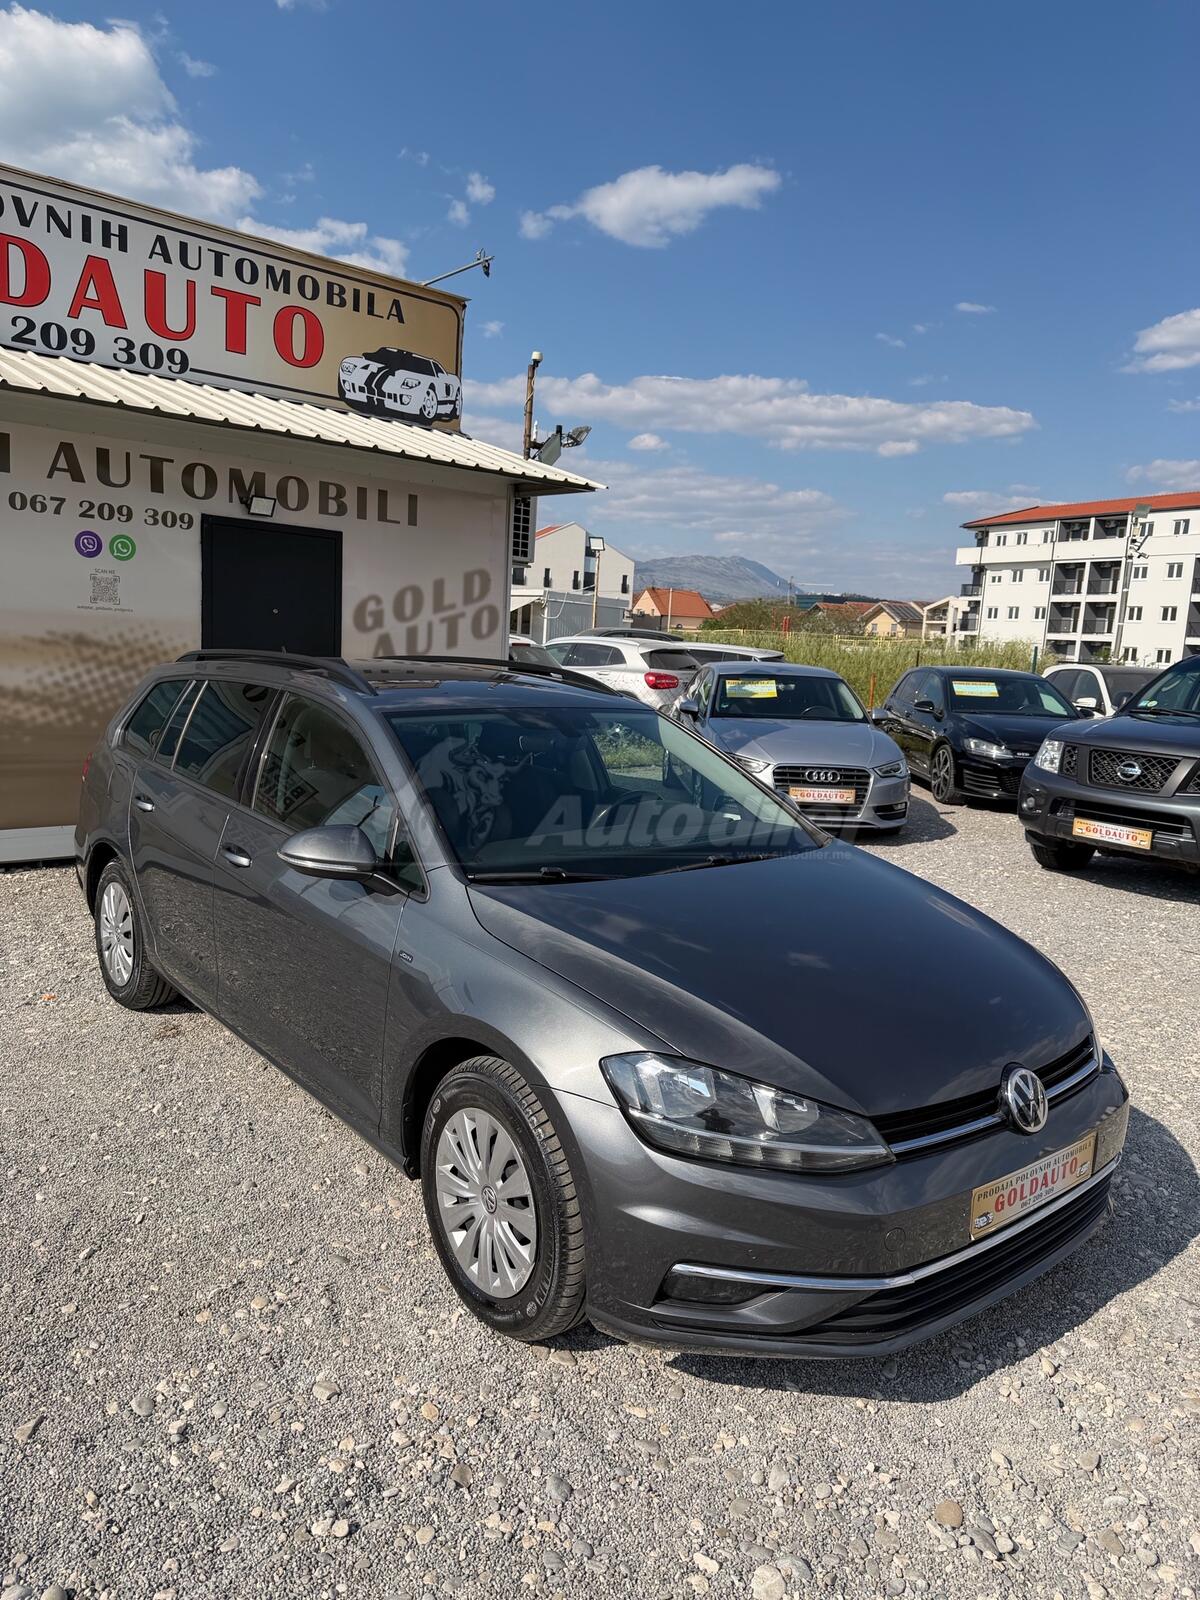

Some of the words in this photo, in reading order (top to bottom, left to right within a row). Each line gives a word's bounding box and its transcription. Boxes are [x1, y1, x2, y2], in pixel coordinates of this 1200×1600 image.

[0, 195, 128, 252] VNIH
[149, 235, 406, 323] AUTOMOBILA
[0, 233, 324, 368] DAUTO
[11, 316, 96, 356] 209
[113, 337, 190, 374] 309
[8, 491, 66, 515] 067
[79, 500, 133, 522] 209
[144, 508, 193, 530] 309
[46, 441, 418, 527] AUTOMOBILI
[352, 568, 492, 634] GOLD
[373, 603, 500, 656] AUTO
[1085, 826, 1138, 841] GOLDAUTO
[977, 1180, 1013, 1202] PRODAJA
[994, 1157, 1079, 1213] GOLDAUTO
